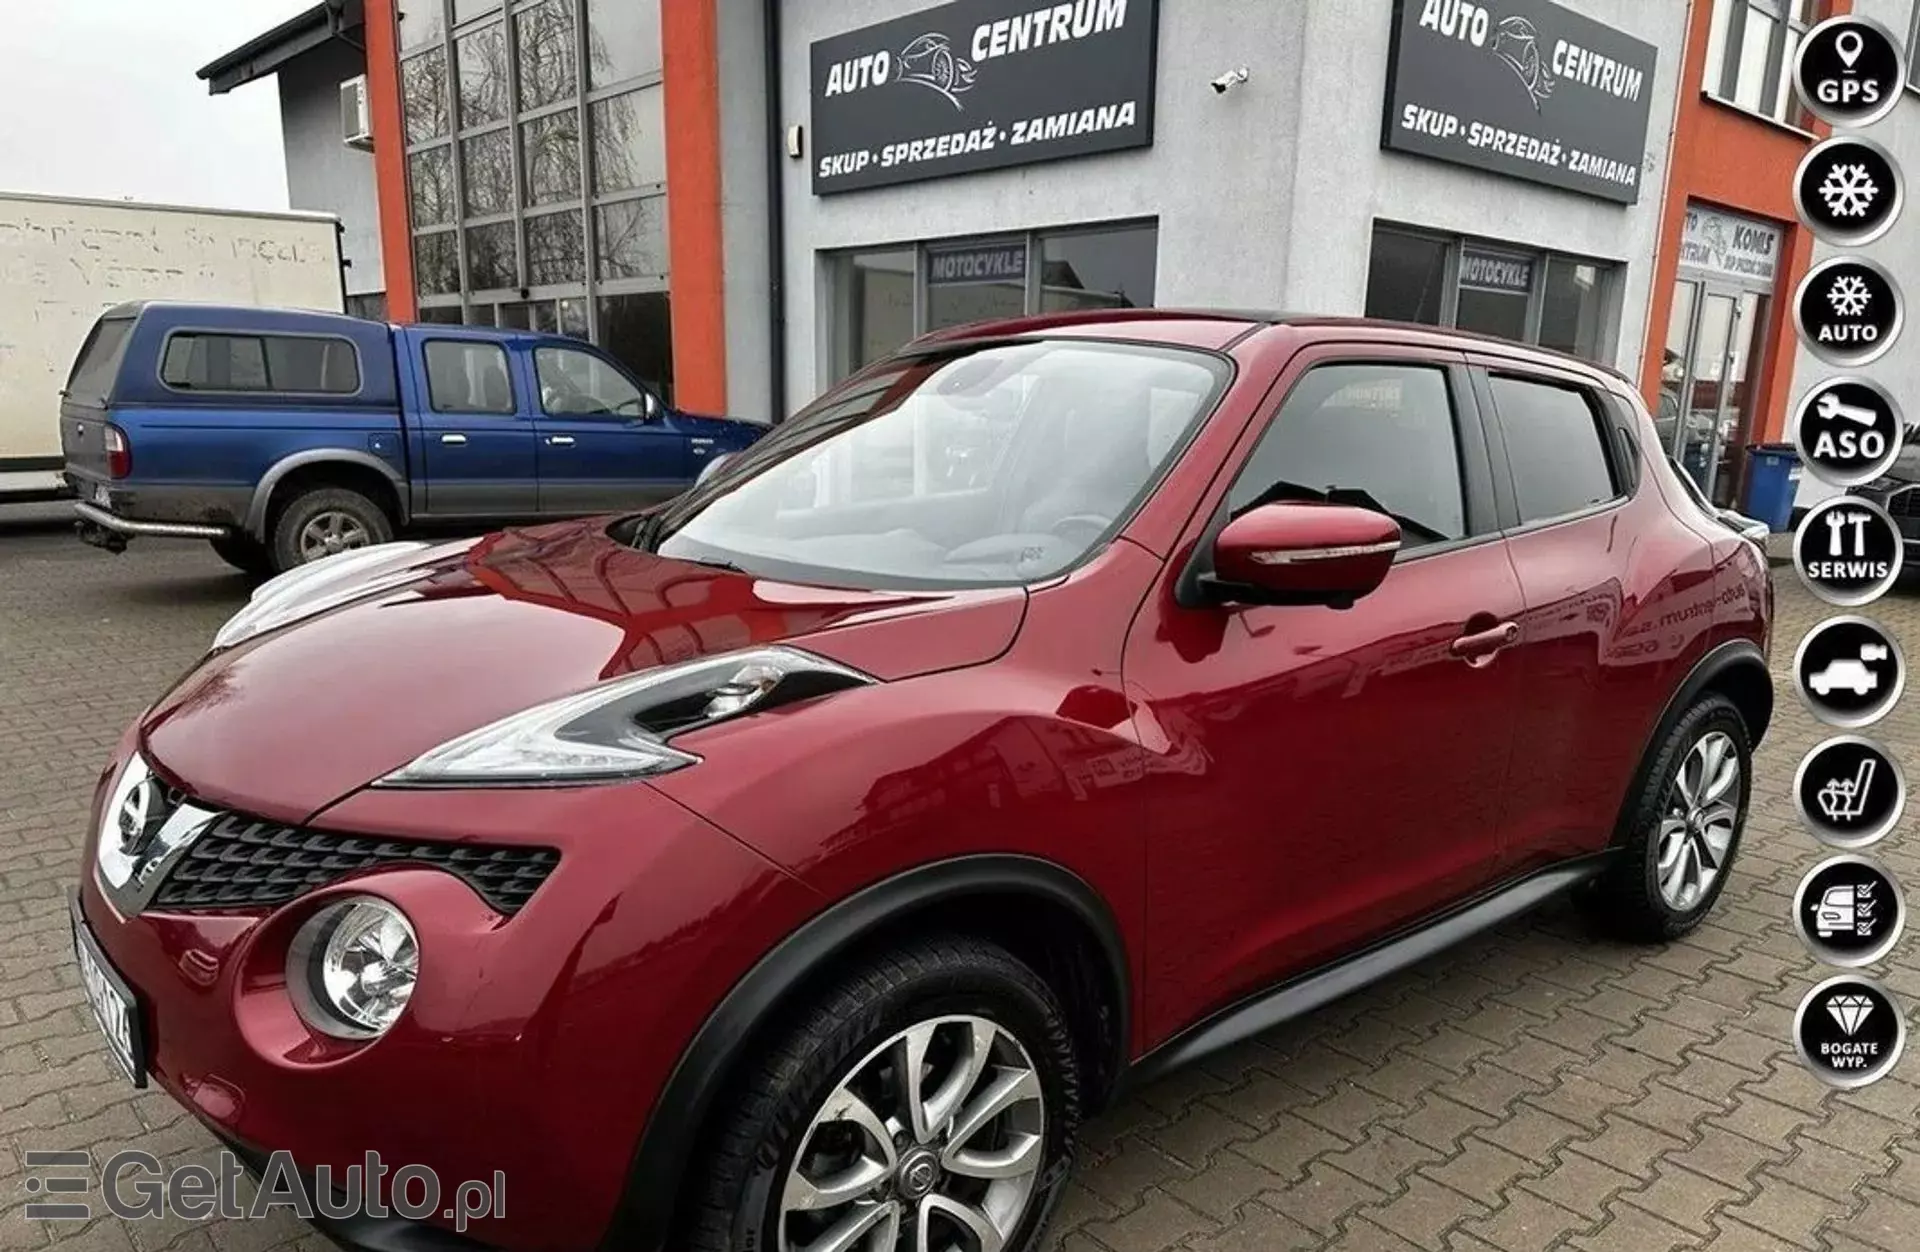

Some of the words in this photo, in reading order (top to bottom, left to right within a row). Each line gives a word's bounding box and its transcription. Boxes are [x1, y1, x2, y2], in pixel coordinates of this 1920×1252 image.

[825, 51, 889, 97] AUTO
[971, 0, 1127, 62] CENTRUM
[1420, 0, 1489, 47] AUTO
[1552, 39, 1643, 101] CENTRUM
[818, 150, 869, 178] SKUP
[880, 120, 996, 167] SPRZEDAŻ
[1010, 101, 1136, 146] ZAMIANA
[1401, 104, 1458, 138] SKUP
[1467, 122, 1562, 167] SPRZEDAŻ
[1568, 150, 1637, 186] ZAMIANA
[931, 250, 1024, 280] MOTOCYKLE
[1461, 255, 1530, 287] MOTOCYKLE
